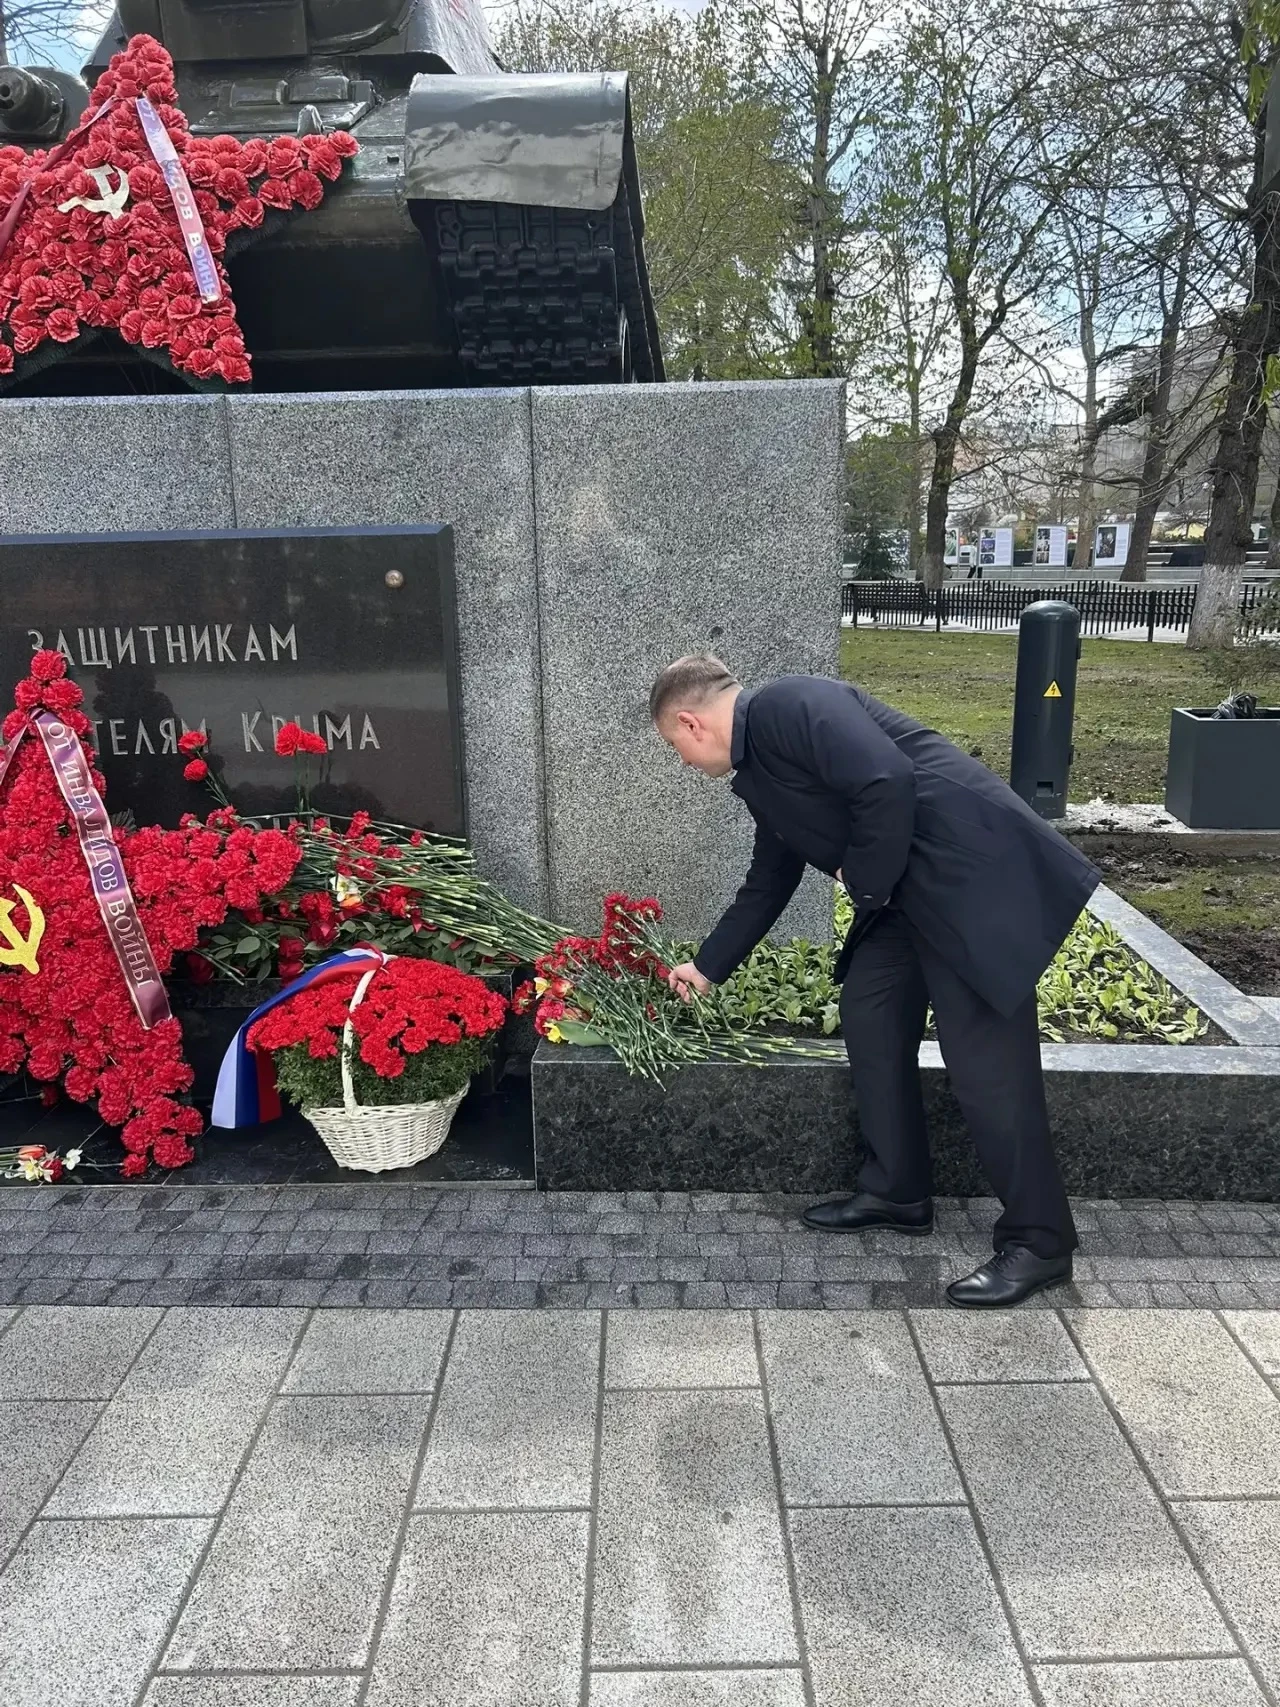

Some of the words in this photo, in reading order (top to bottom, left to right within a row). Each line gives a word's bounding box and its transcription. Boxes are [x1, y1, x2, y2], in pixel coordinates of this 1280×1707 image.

[27, 623, 299, 669] ЗАЩИТНИКАМ
[47, 721, 72, 751] ОТ
[60, 758, 119, 892] ИНВАЛИДОВ
[107, 898, 154, 989] ВОЙНЫ
